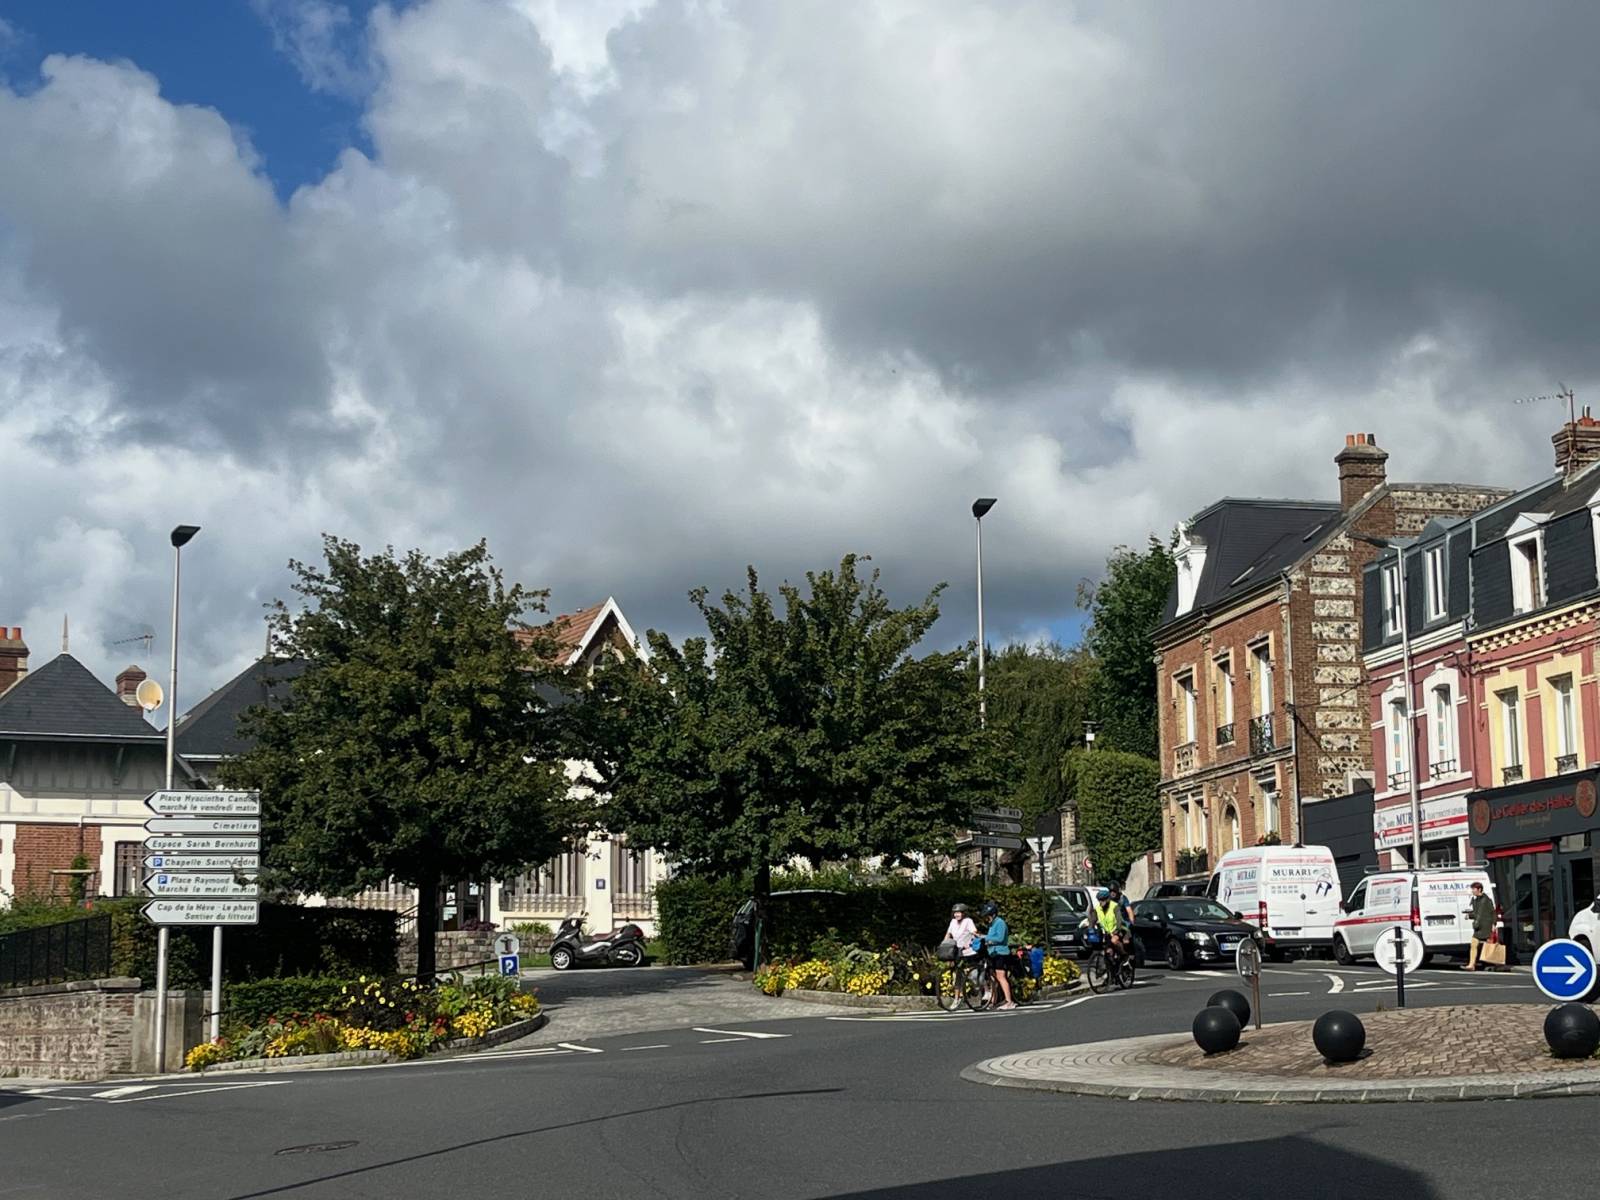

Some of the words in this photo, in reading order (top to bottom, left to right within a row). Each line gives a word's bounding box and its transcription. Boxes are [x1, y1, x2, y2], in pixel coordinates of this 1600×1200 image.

[160, 794, 181, 802] Place
[152, 840, 182, 848] Espace
[187, 840, 211, 848] Sarah
[215, 840, 256, 848] Bernhardt
[165, 858, 201, 867] Chapelle
[195, 876, 230, 885] Raymond
[158, 885, 188, 893] Marché
[192, 885, 200, 893] le
[205, 885, 228, 893] mardi
[175, 903, 184, 911] de
